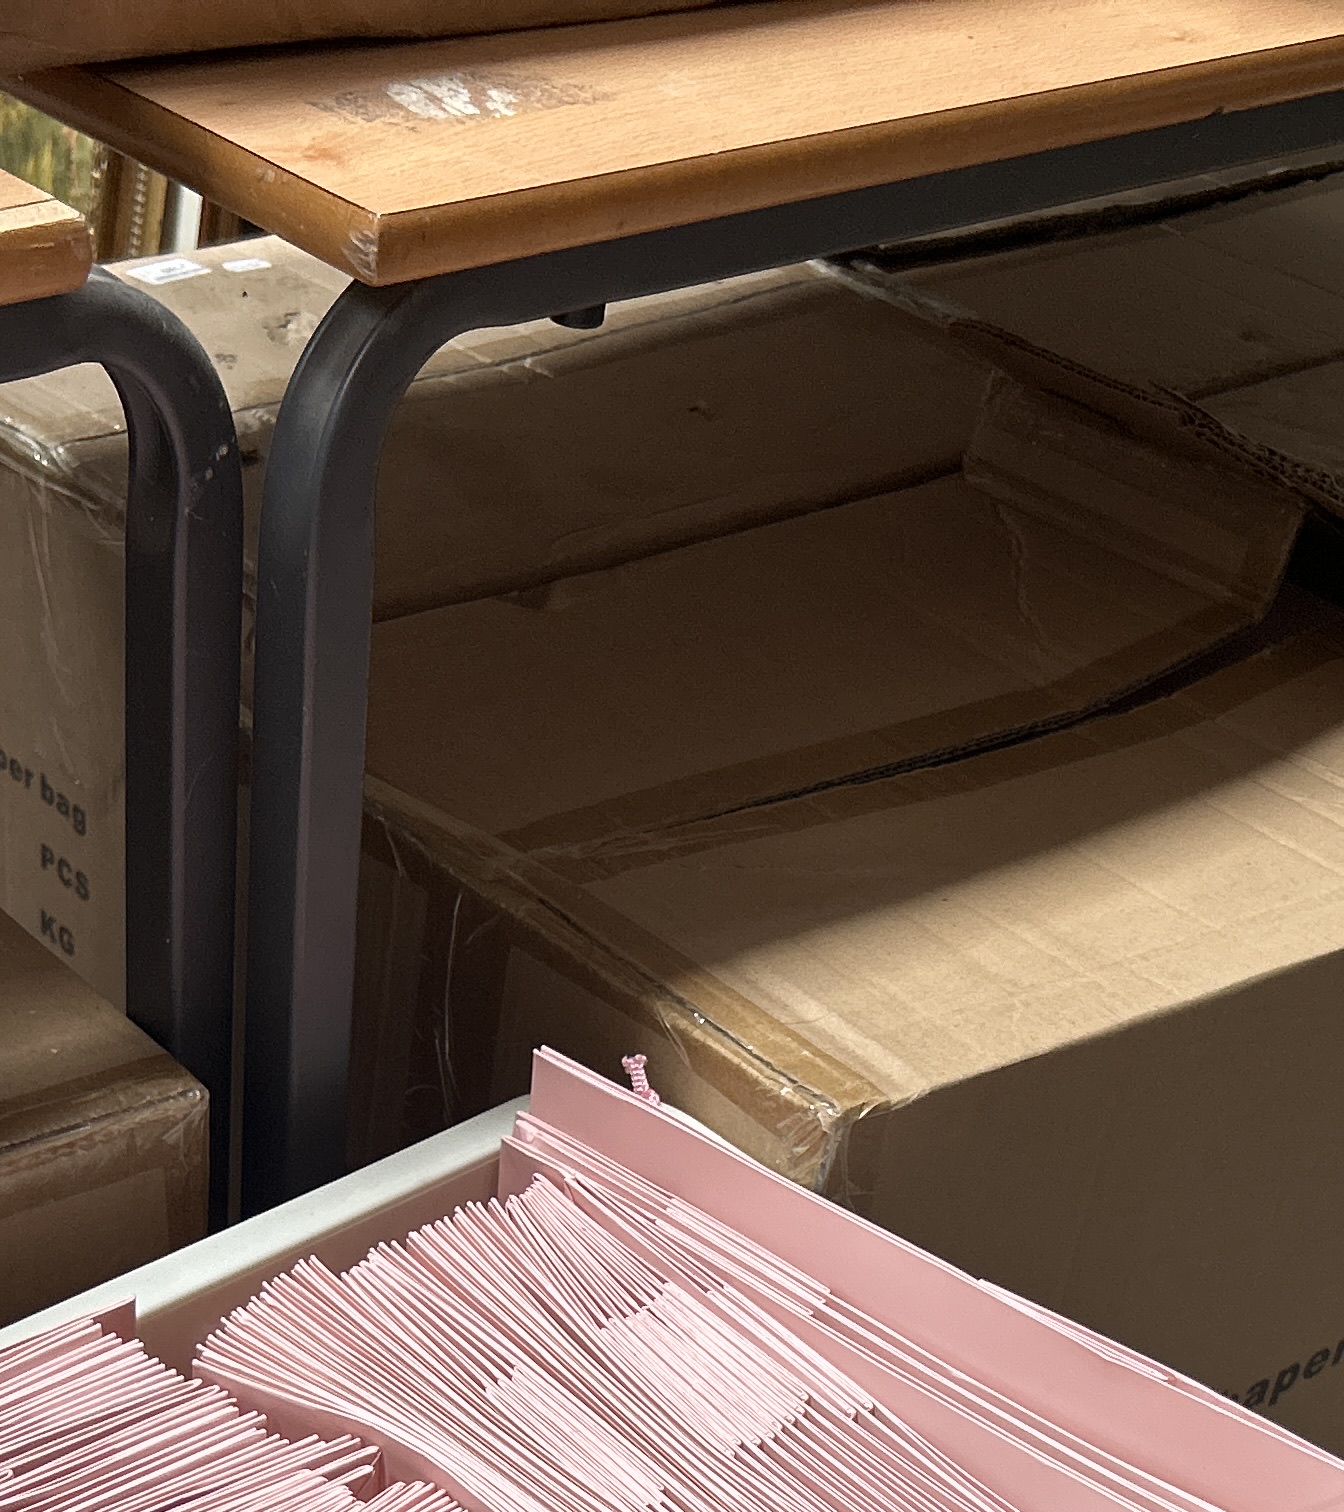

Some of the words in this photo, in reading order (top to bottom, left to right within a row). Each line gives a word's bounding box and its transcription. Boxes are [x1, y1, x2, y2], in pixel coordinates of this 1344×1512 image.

[40, 773, 87, 836] bag
[40, 843, 90, 901] PCS
[40, 909, 75, 957] KG
